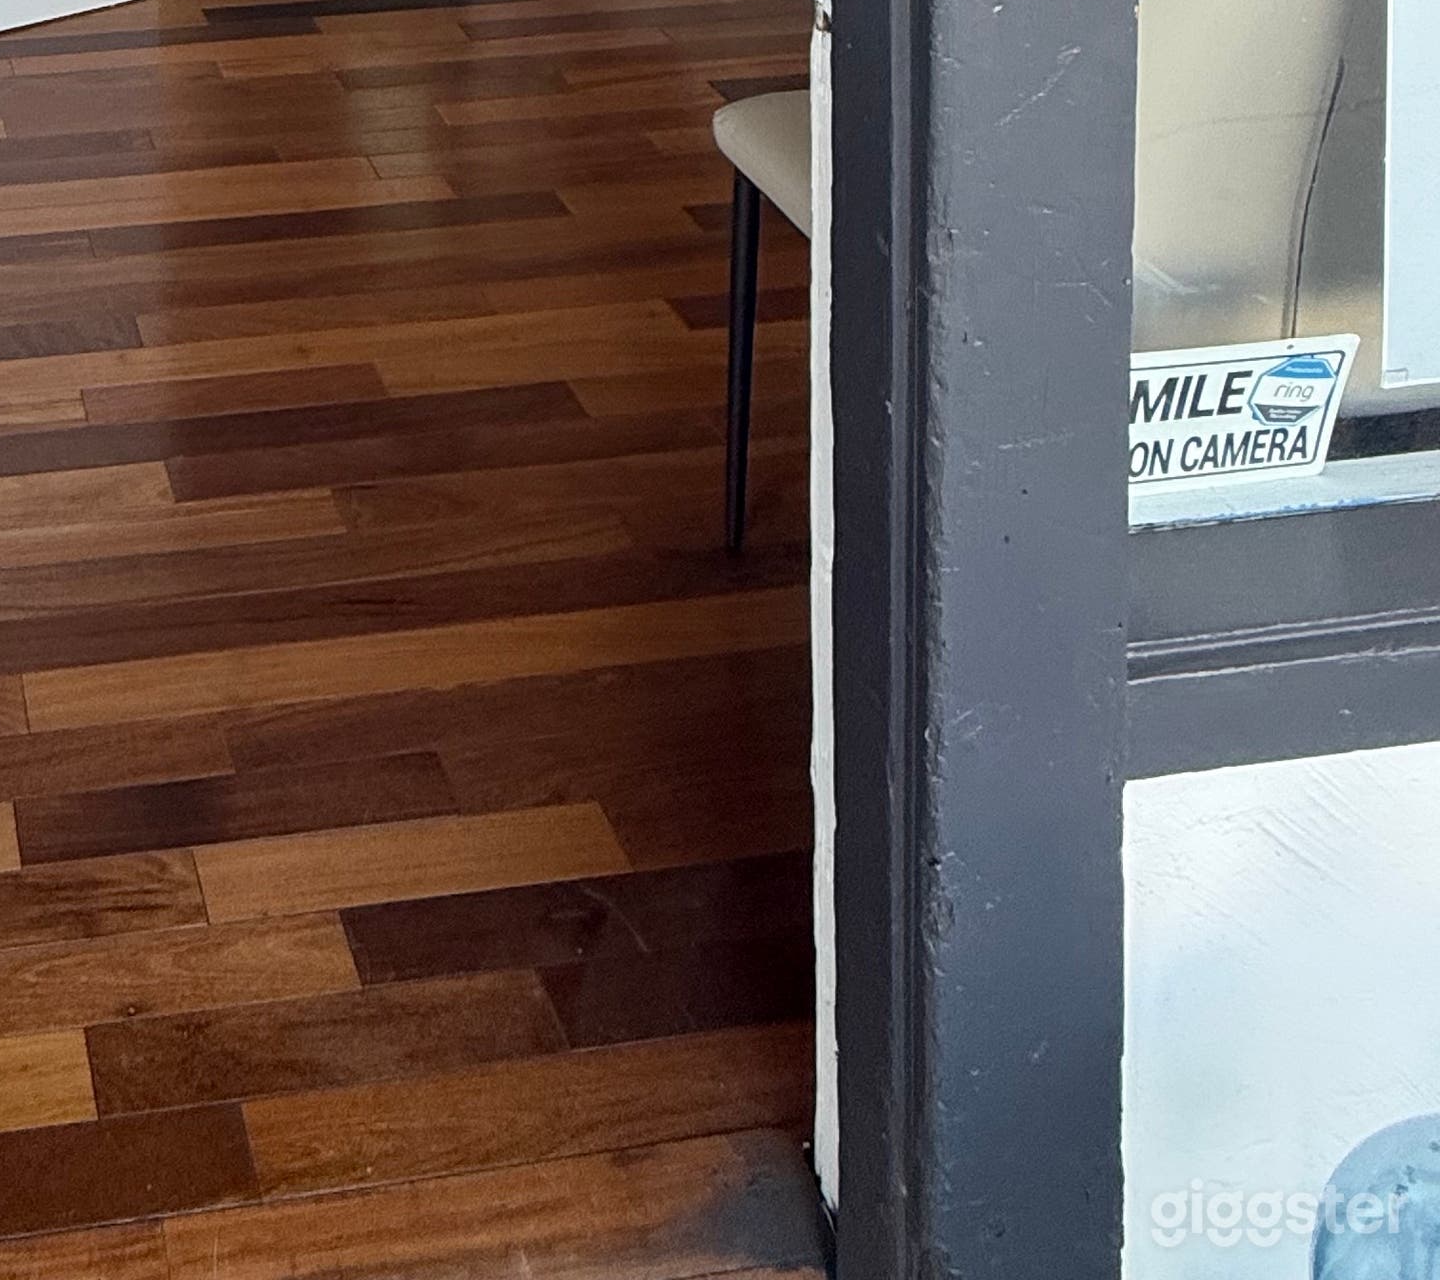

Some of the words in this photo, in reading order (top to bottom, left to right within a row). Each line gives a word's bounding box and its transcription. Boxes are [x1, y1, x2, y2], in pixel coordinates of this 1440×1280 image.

[1274, 381, 1315, 402] ring
[1129, 439, 1174, 477] ON
[1180, 425, 1308, 472] CAMERA
